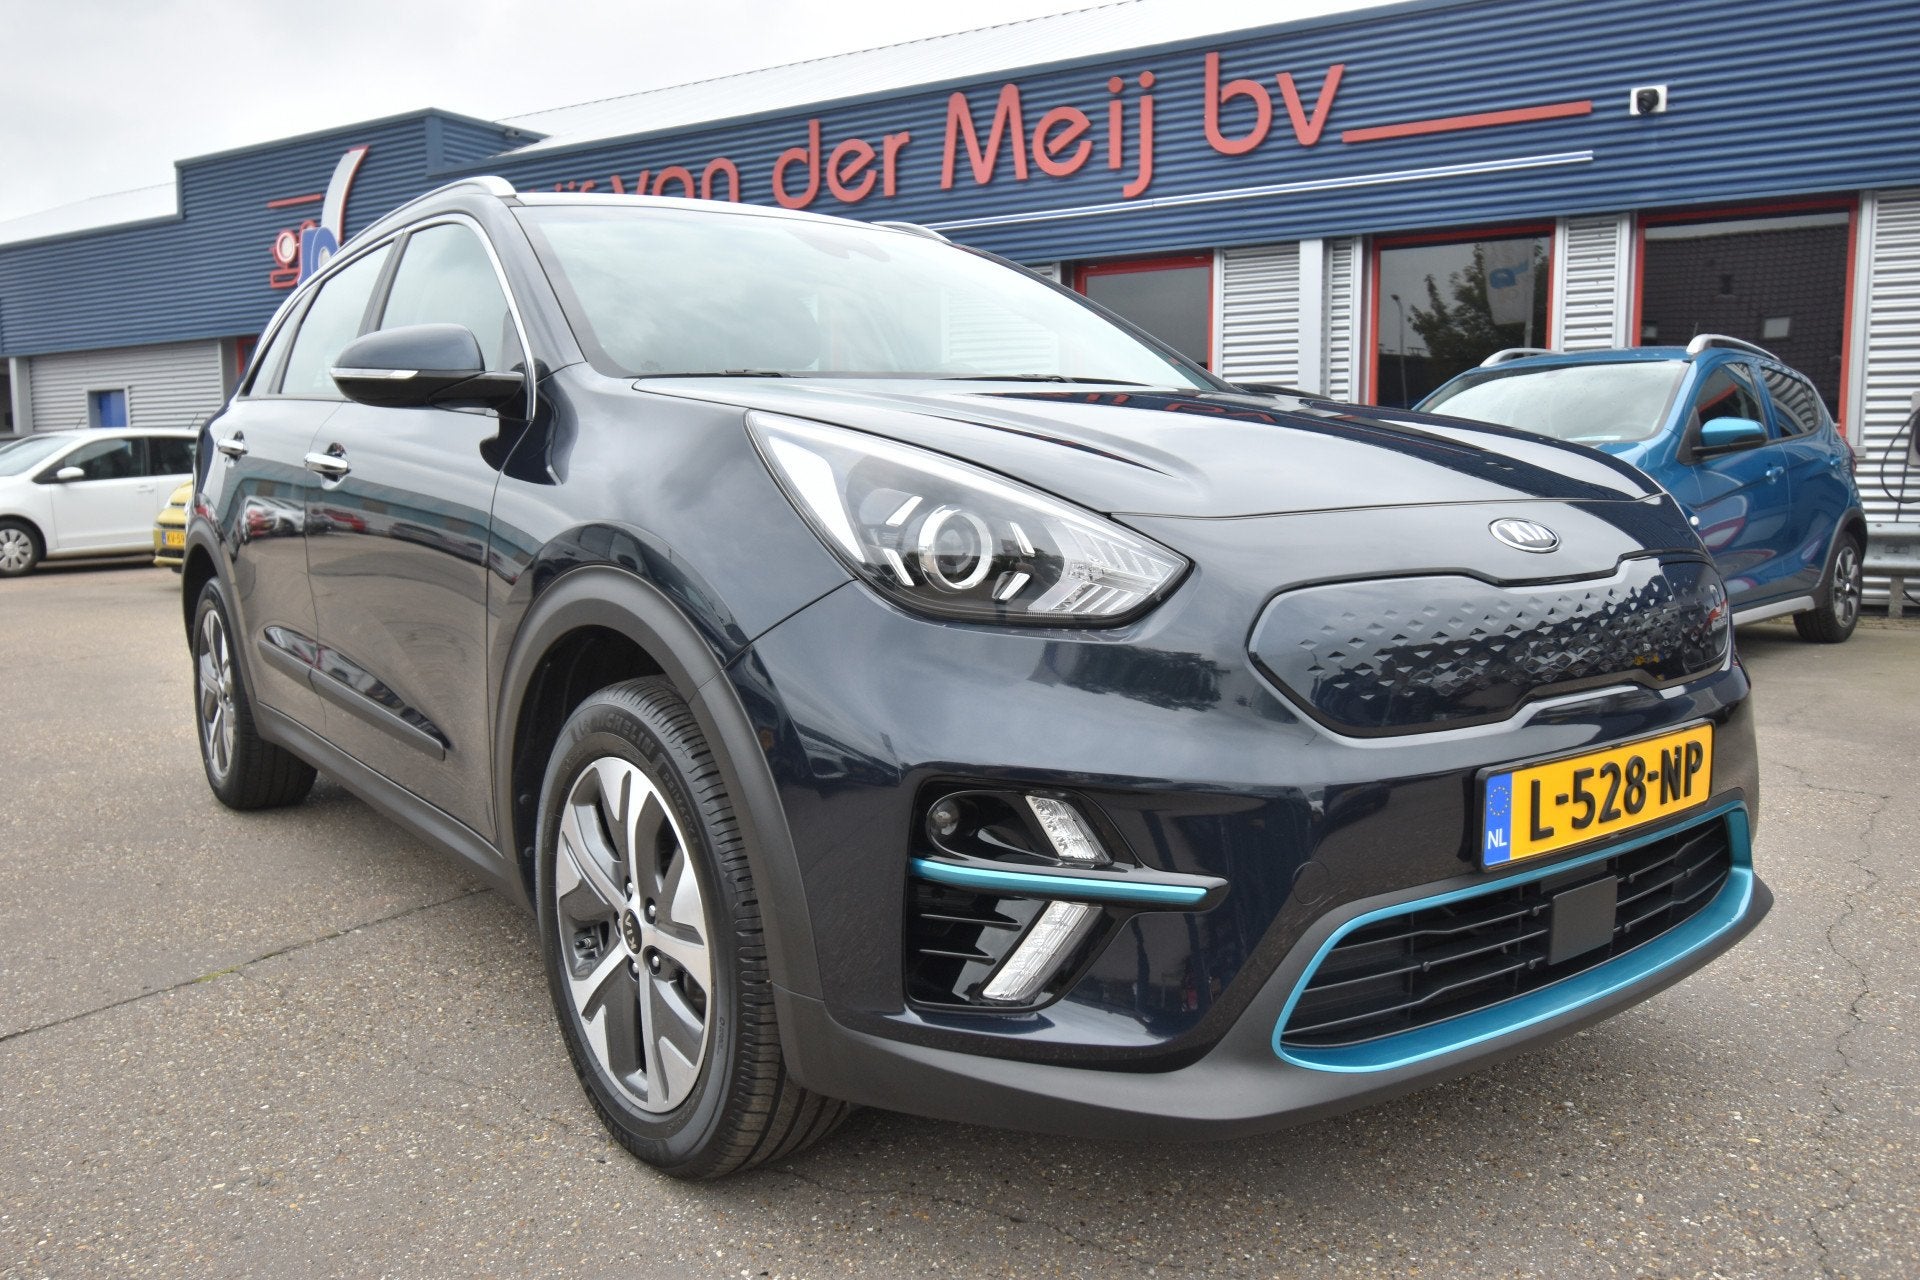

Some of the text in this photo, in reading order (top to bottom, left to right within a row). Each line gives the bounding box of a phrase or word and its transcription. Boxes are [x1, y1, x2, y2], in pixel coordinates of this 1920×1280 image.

[772, 118, 910, 210] der
[940, 70, 1156, 199] Meij
[1204, 51, 1345, 156] bv
[1500, 521, 1556, 543] KIA
[1529, 740, 1704, 842] L-528-NP
[1487, 827, 1508, 850] NL
[624, 913, 638, 950] KIA
